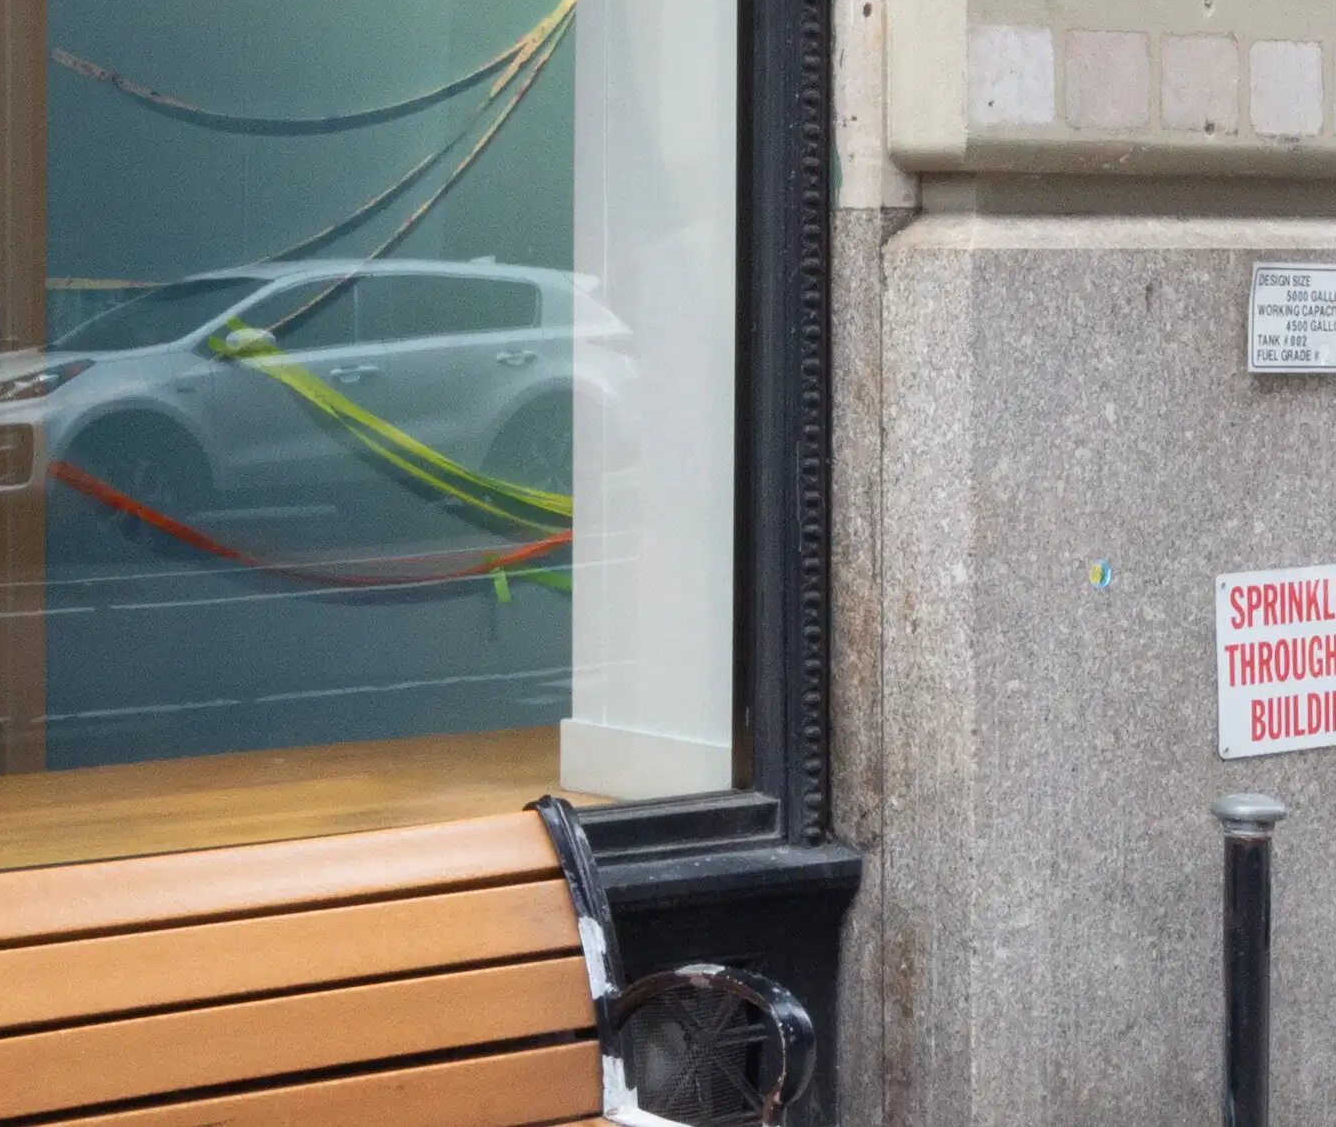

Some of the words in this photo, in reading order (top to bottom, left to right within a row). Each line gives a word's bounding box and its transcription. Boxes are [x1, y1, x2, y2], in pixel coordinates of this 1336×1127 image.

[1258, 274, 1291, 287] DESIGN
[1293, 275, 1311, 287] SIZE
[1286, 290, 1309, 302] 5000
[1257, 304, 1300, 317] WORKING
[1285, 320, 1308, 332] 4500
[1257, 334, 1281, 346] TANK
[1256, 349, 1278, 361] FUEL
[1281, 350, 1311, 362] GRADE
